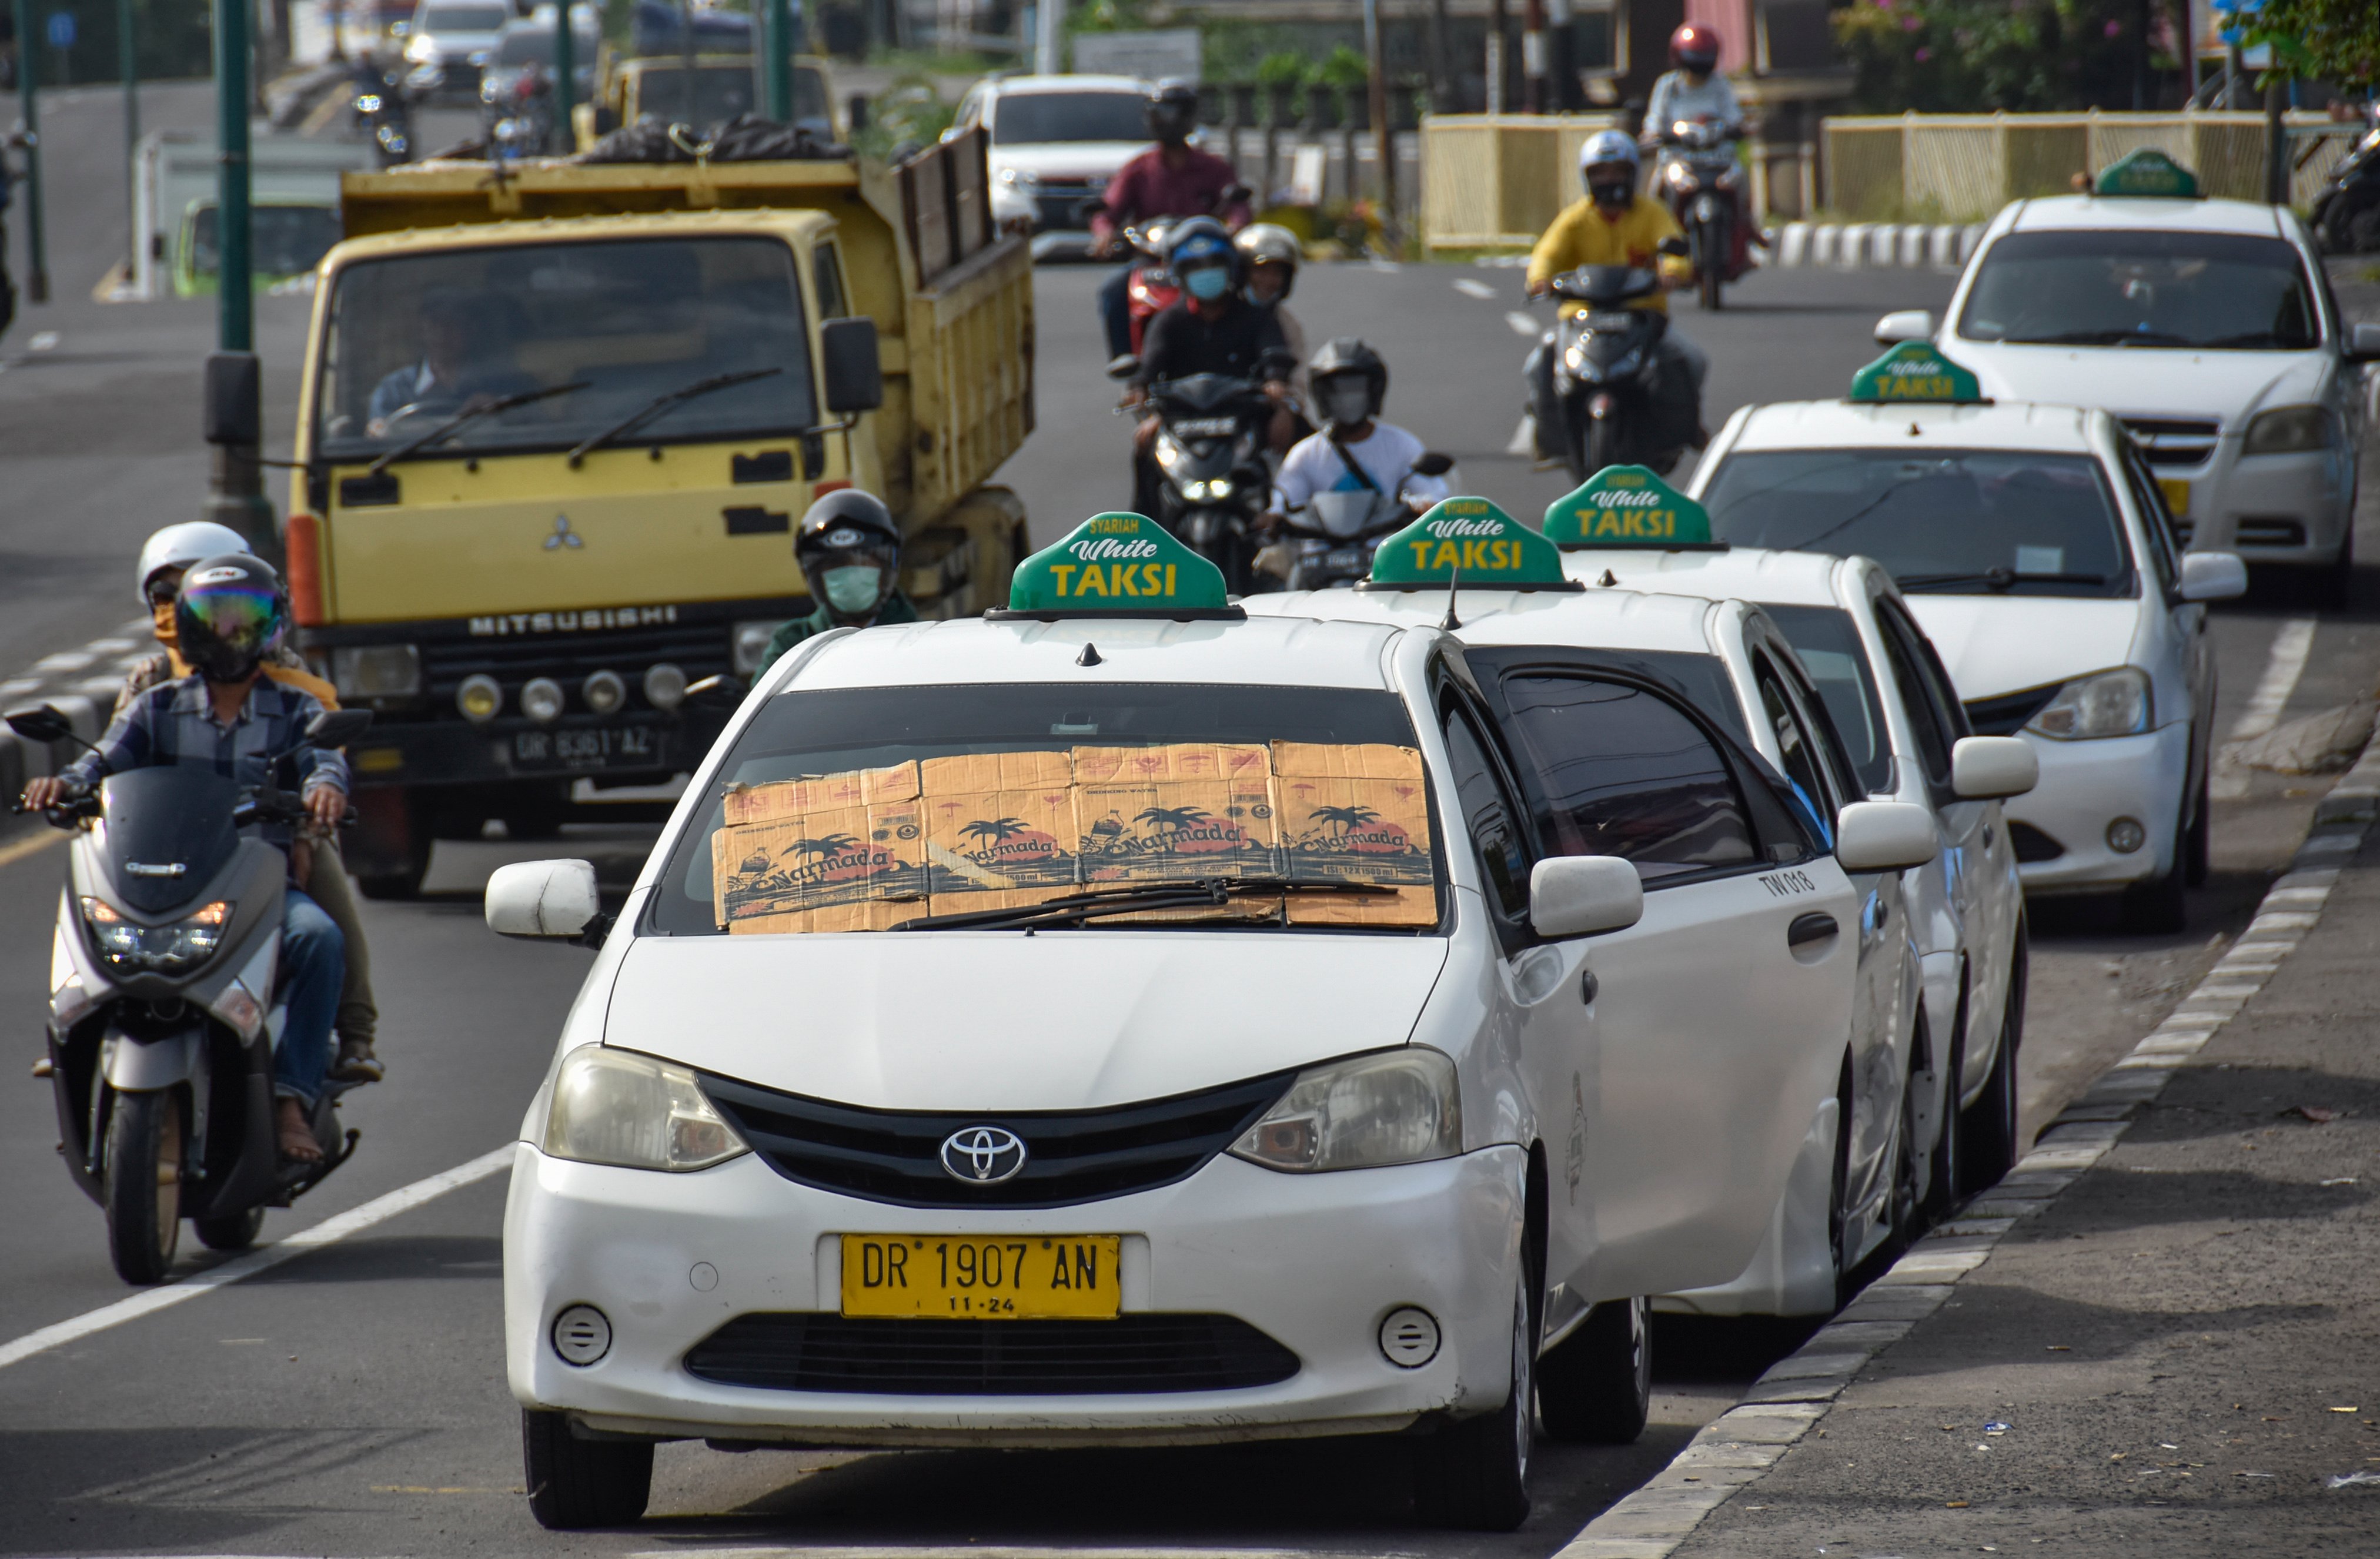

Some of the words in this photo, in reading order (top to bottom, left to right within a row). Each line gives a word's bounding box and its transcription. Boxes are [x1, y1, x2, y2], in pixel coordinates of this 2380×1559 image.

[1875, 375, 1955, 398] TAKSI
[1590, 489, 1662, 508] White
[1089, 518, 1139, 534] SYARIAH
[1426, 518, 1505, 538] White
[1575, 509, 1675, 537] TAKSI
[1068, 537, 1164, 561] White
[1409, 540, 1522, 570] TAKSI
[1049, 563, 1176, 597] TAKSI
[469, 604, 677, 636] MITSUBISHI
[962, 838, 1053, 863] Narmada
[1122, 823, 1241, 854] Narmada
[1314, 829, 1405, 852] Narmada
[770, 848, 888, 891] Narmada
[862, 1243, 908, 1288] DR
[936, 1243, 1027, 1289] 1907
[1051, 1244, 1097, 1290] AN
